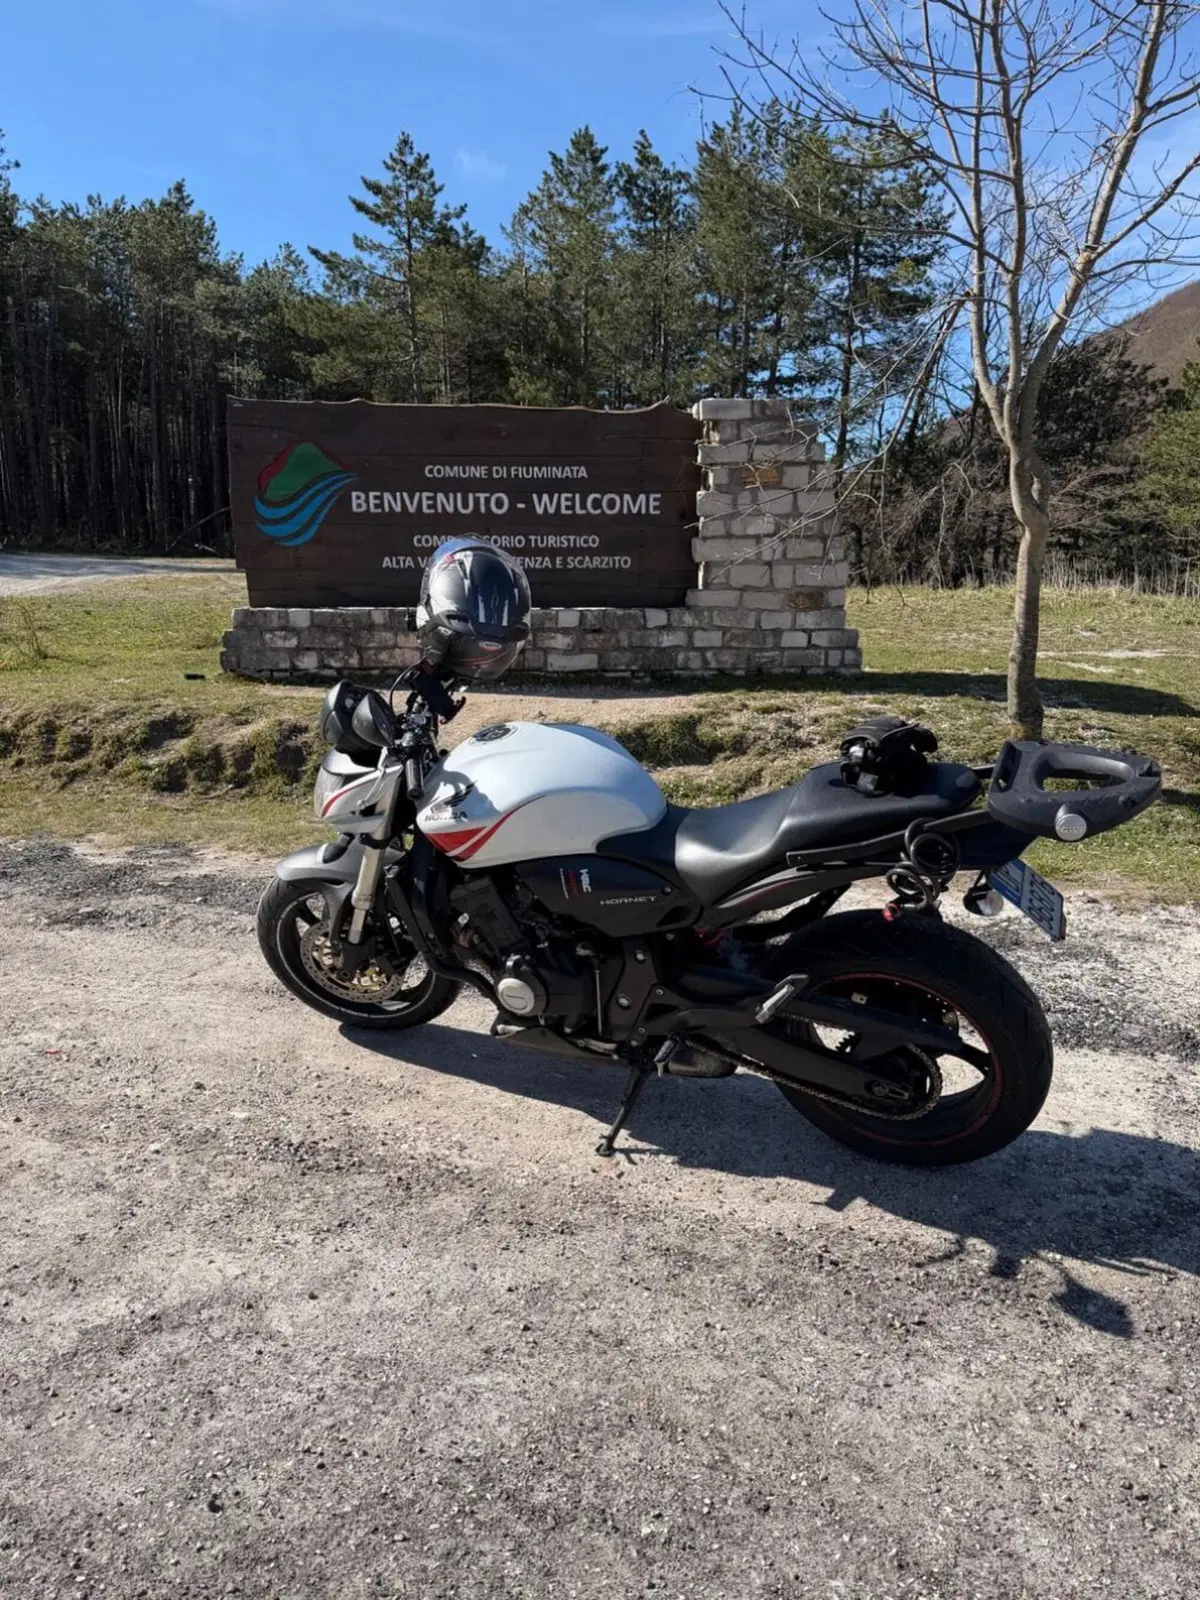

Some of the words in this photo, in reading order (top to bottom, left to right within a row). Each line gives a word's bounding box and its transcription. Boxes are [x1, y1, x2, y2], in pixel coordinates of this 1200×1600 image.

[425, 465, 488, 479] COMUNE
[492, 465, 507, 479] DI
[511, 466, 588, 480] FIUMINATA
[350, 490, 510, 514] BENVENUTO
[532, 492, 662, 515] WELCOME
[528, 535, 600, 548] TURISTICO
[381, 556, 415, 569] ALTA
[555, 556, 563, 569] E
[566, 556, 632, 569] SCARZITO
